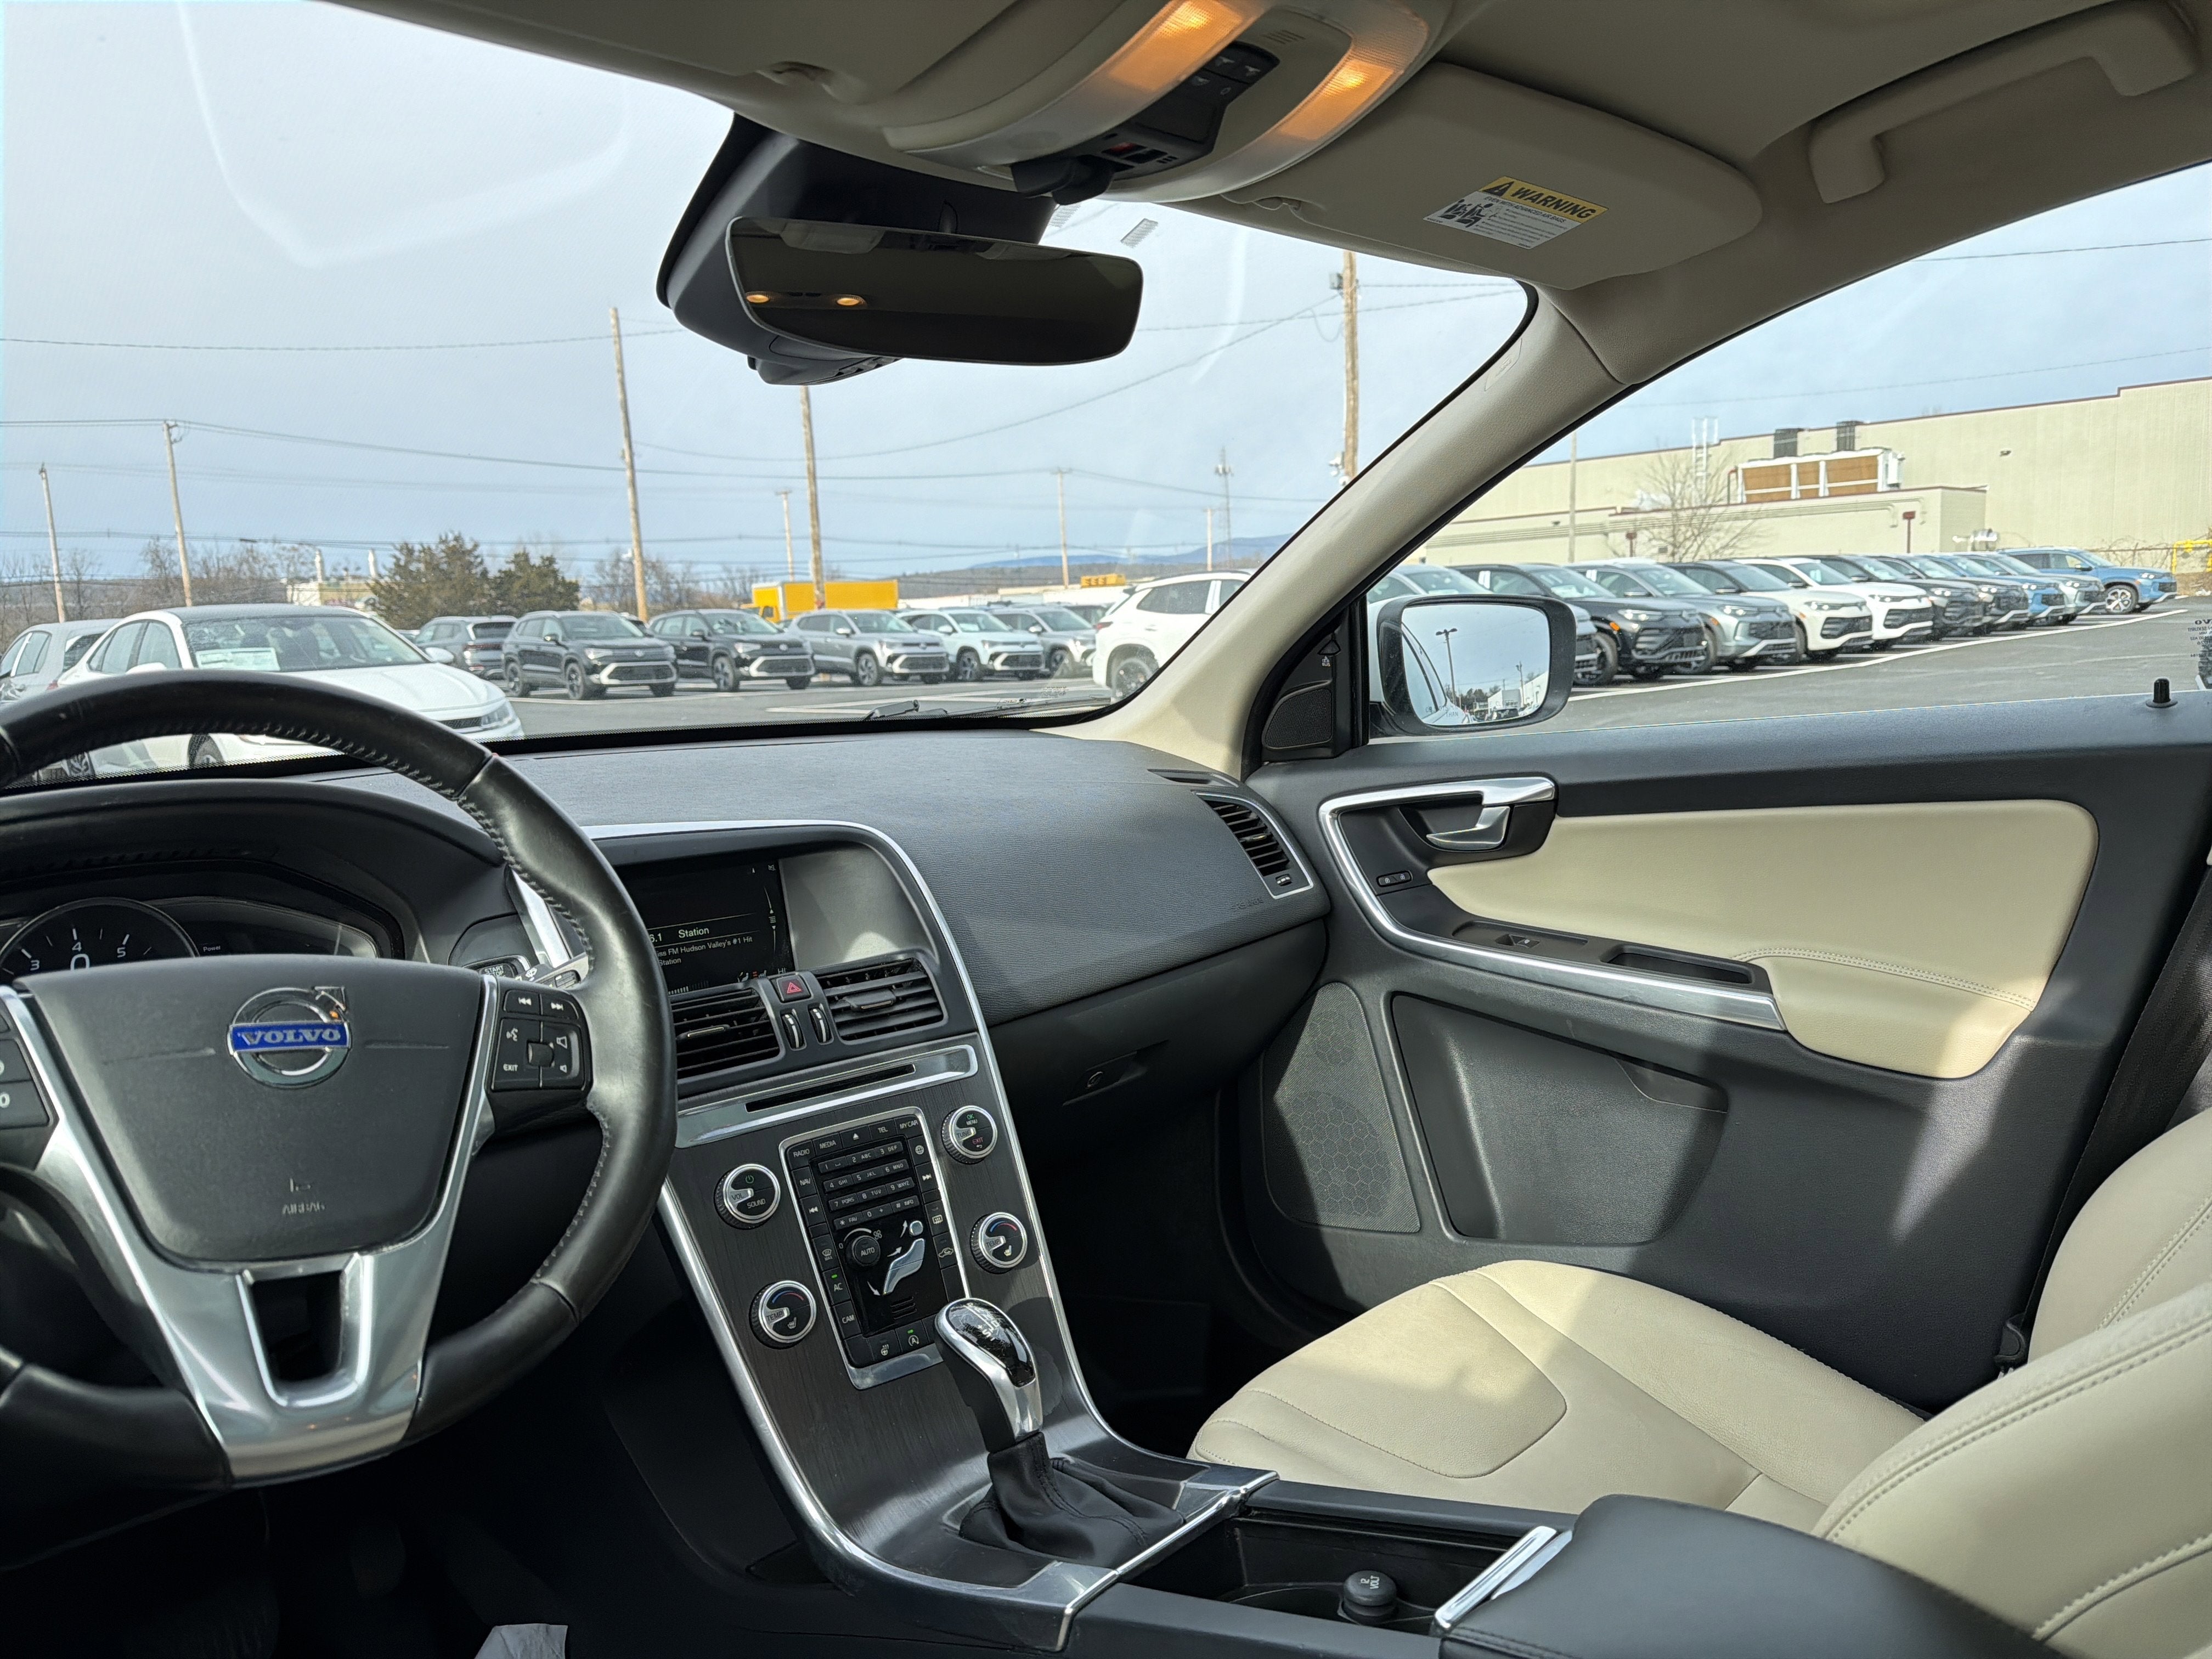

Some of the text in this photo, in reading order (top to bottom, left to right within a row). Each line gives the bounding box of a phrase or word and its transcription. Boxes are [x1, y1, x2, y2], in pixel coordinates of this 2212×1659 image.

[1510, 187, 1596, 218] WARNING
[649, 927, 709, 943] 6.1 Station
[72, 941, 82, 951] 4
[668, 947, 679, 956] FM
[680, 944, 706, 953] Hudson
[707, 939, 731, 949] Valley's
[117, 947, 126, 958] 5
[30, 960, 40, 971] 3
[658, 957, 682, 966] Station
[484, 965, 504, 973] START
[238, 1028, 341, 1046] VOLVO
[503, 1063, 518, 1071] EXIT
[956, 1130, 970, 1138] TUNE
[819, 1139, 837, 1149] MEDIA
[793, 1148, 810, 1158] RADIO
[800, 1178, 811, 1186] NAV
[747, 1198, 766, 1209] SOUND
[986, 1239, 1000, 1248] TEMP
[861, 1247, 875, 1256] AUTO
[833, 1283, 843, 1292] AC
[766, 1311, 784, 1322] TEMP
[842, 1314, 855, 1324] CAM
[1369, 1575, 1380, 1589] VOLT
